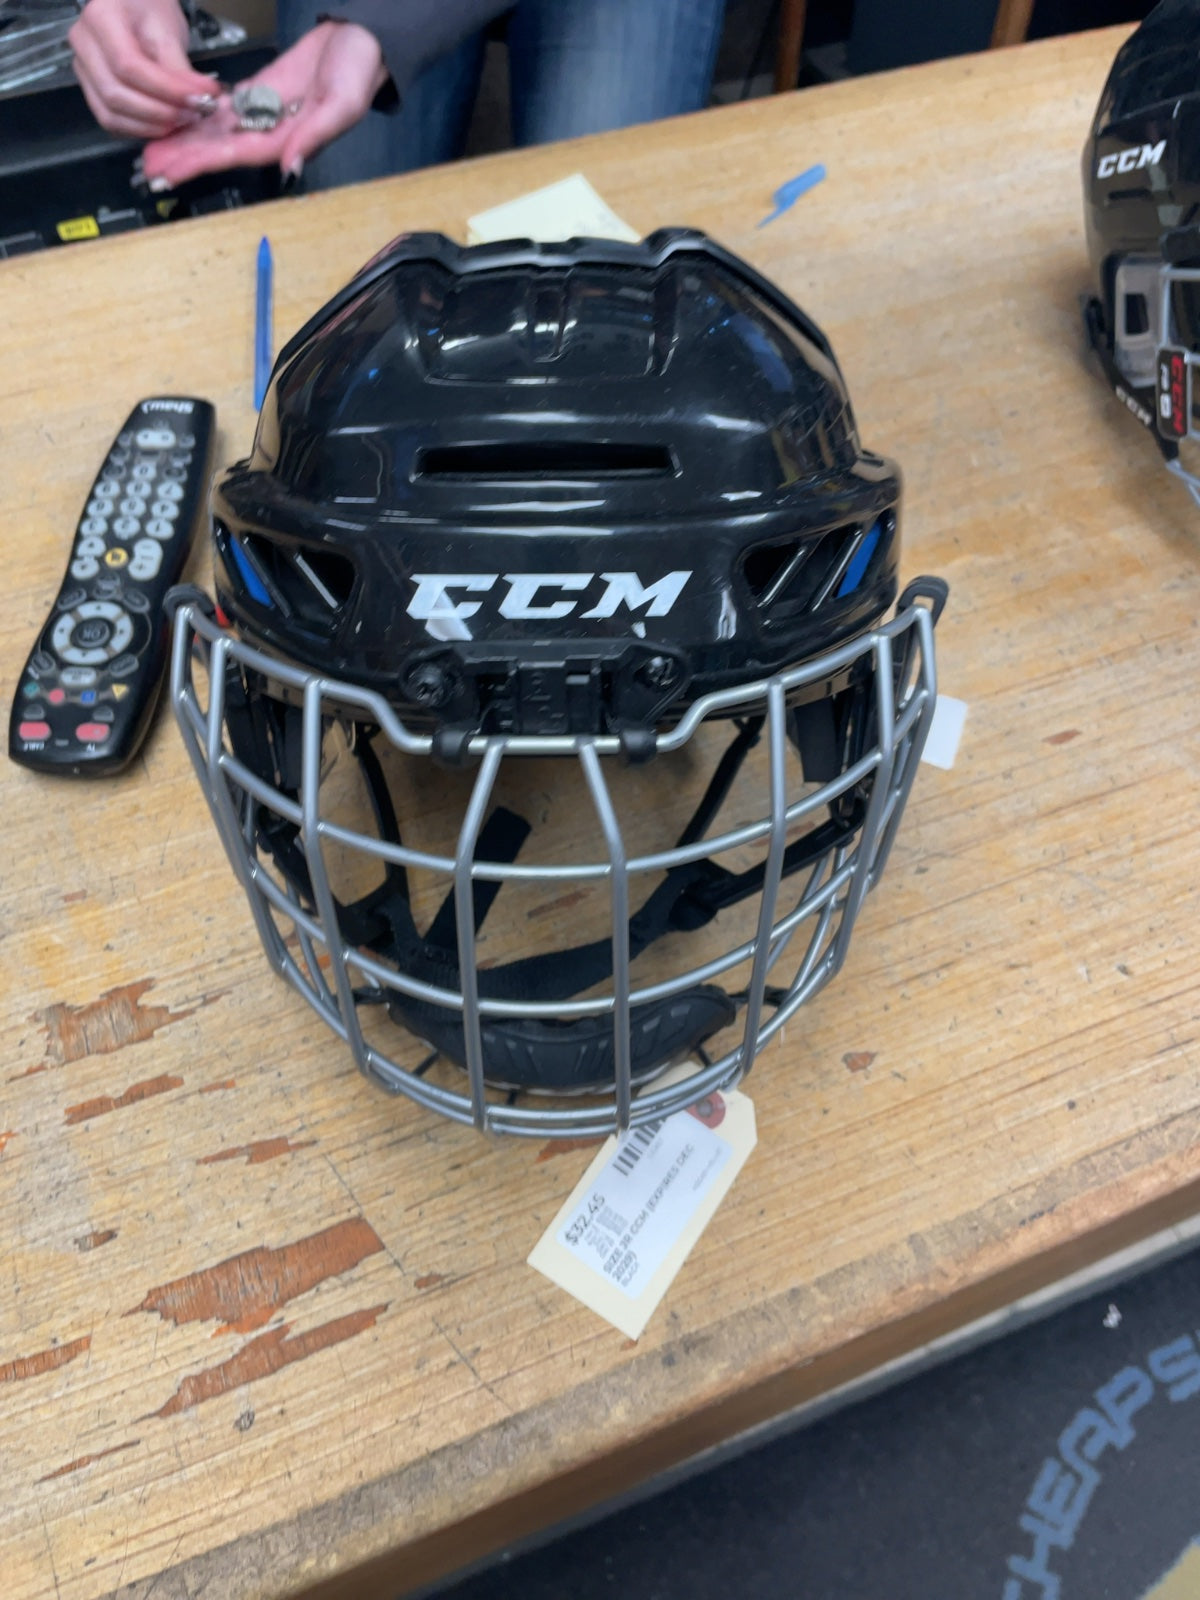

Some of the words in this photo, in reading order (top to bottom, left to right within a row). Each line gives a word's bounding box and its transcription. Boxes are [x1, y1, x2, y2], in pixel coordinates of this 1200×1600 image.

[1097, 140, 1167, 179] CCM
[1171, 355, 1184, 434] CCM
[406, 570, 693, 620] CCM
[629, 1210, 649, 1235] CCM
[676, 1144, 694, 1166] DEC
[564, 1193, 606, 1246] $32.45
